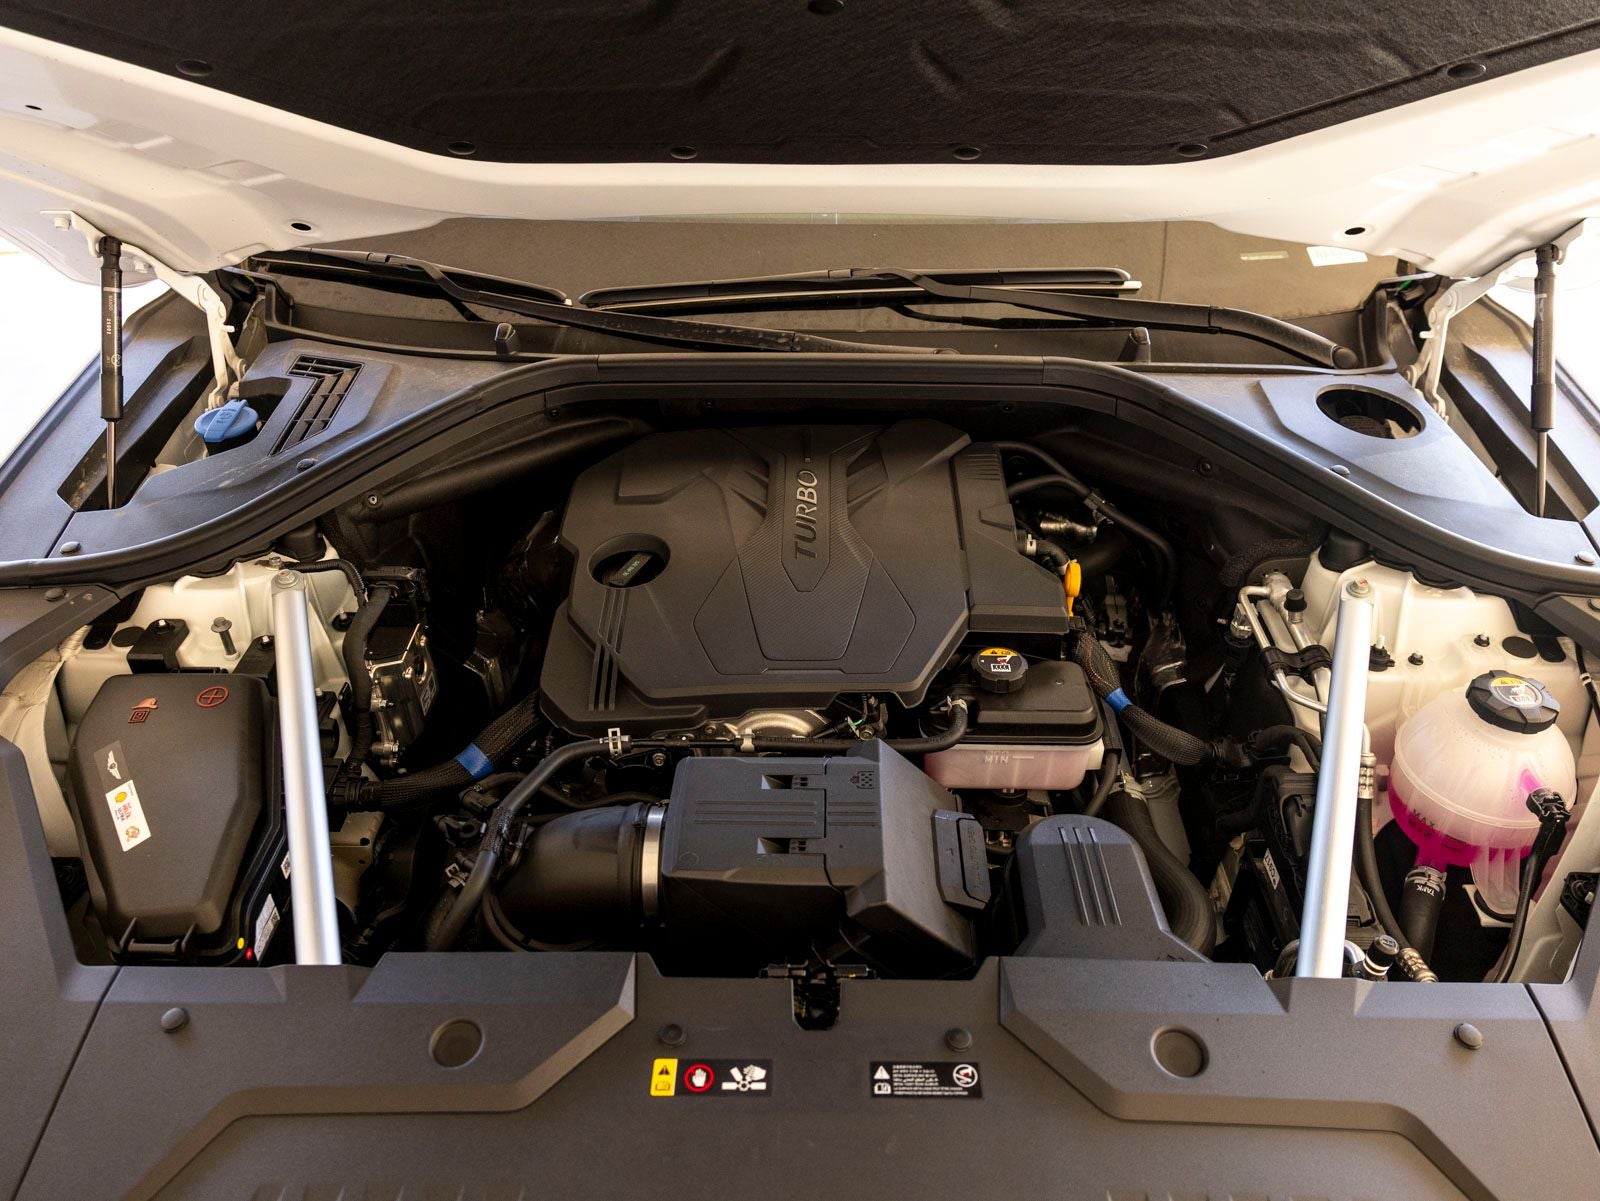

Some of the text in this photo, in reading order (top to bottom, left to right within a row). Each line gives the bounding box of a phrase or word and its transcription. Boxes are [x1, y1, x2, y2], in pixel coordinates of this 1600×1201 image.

[794, 470, 818, 559] TURBO
[984, 755, 1009, 764] MIN
[1416, 884, 1435, 896] TANK
